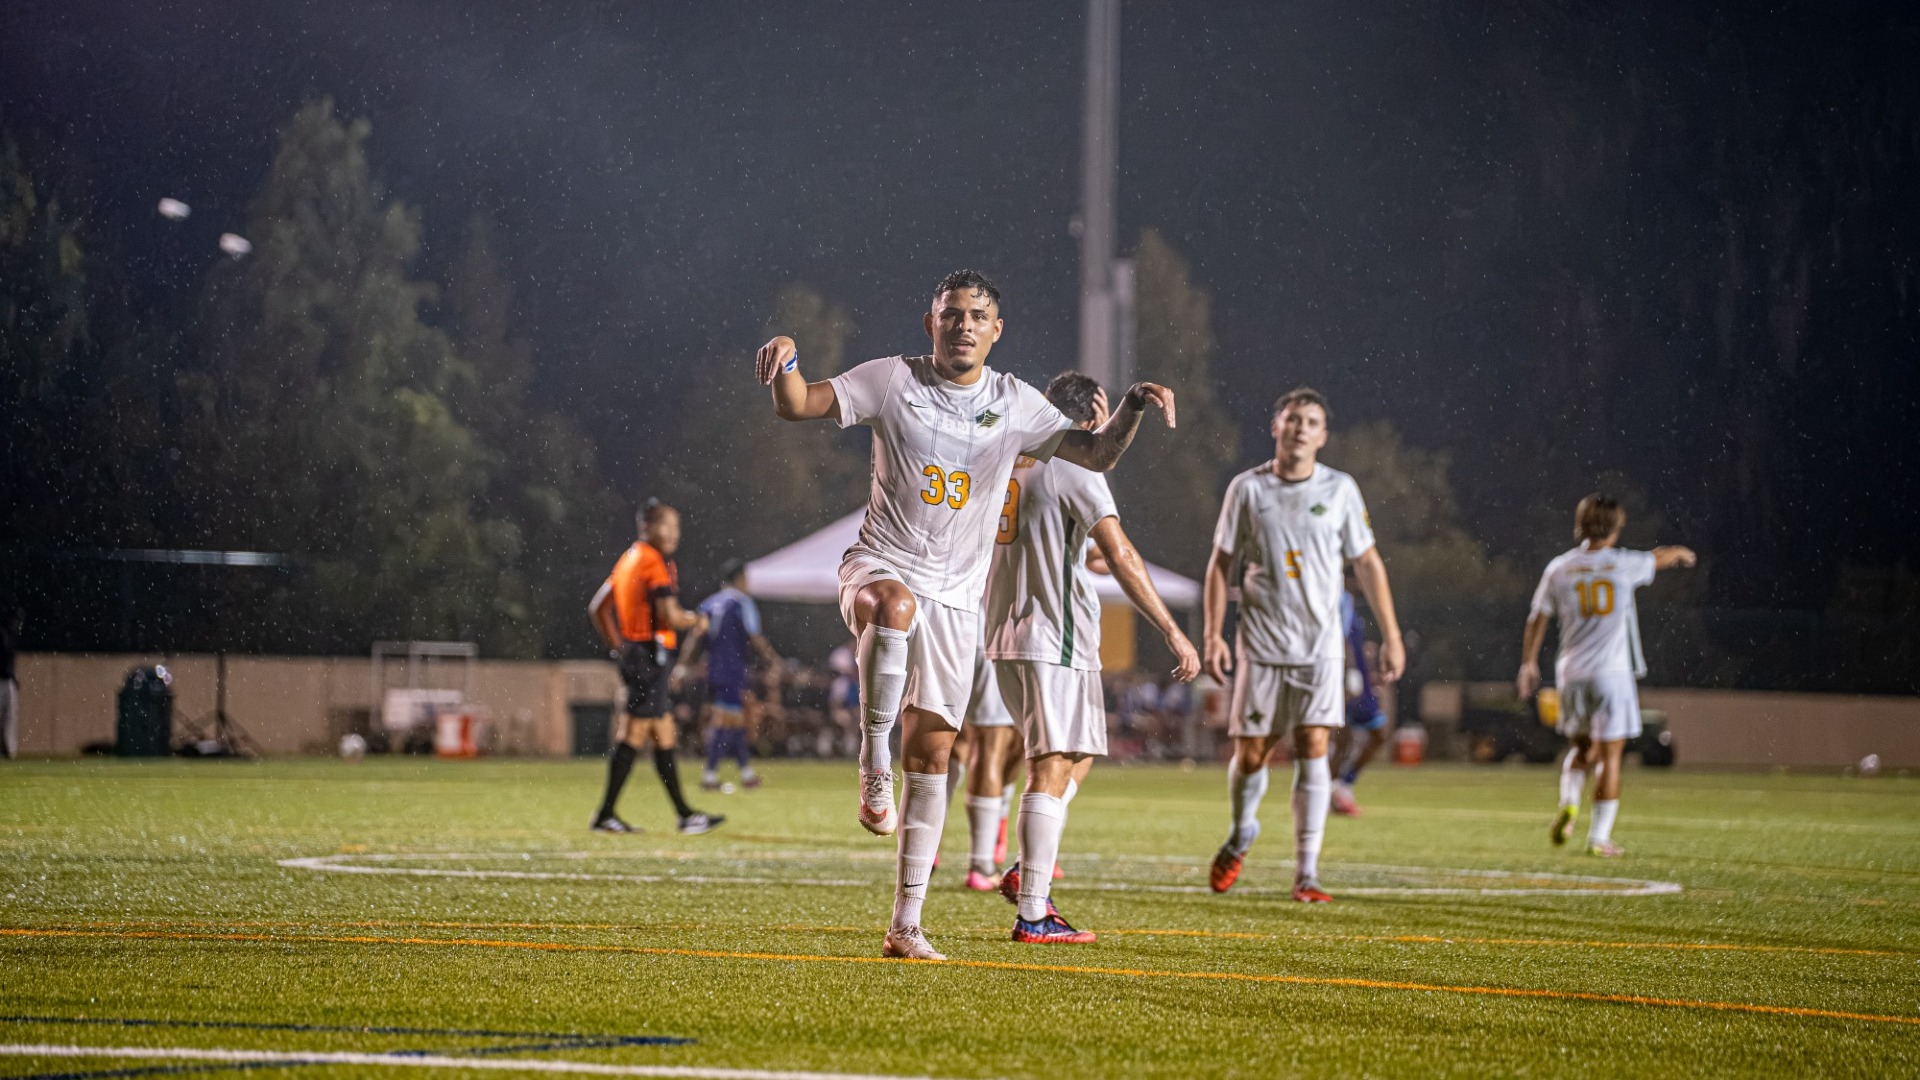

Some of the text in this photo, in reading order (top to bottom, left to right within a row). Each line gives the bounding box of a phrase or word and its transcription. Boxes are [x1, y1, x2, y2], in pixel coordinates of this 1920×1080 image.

[920, 465, 971, 510] 33
[1285, 551, 1303, 579] 5
[1575, 578, 1615, 618] 10
